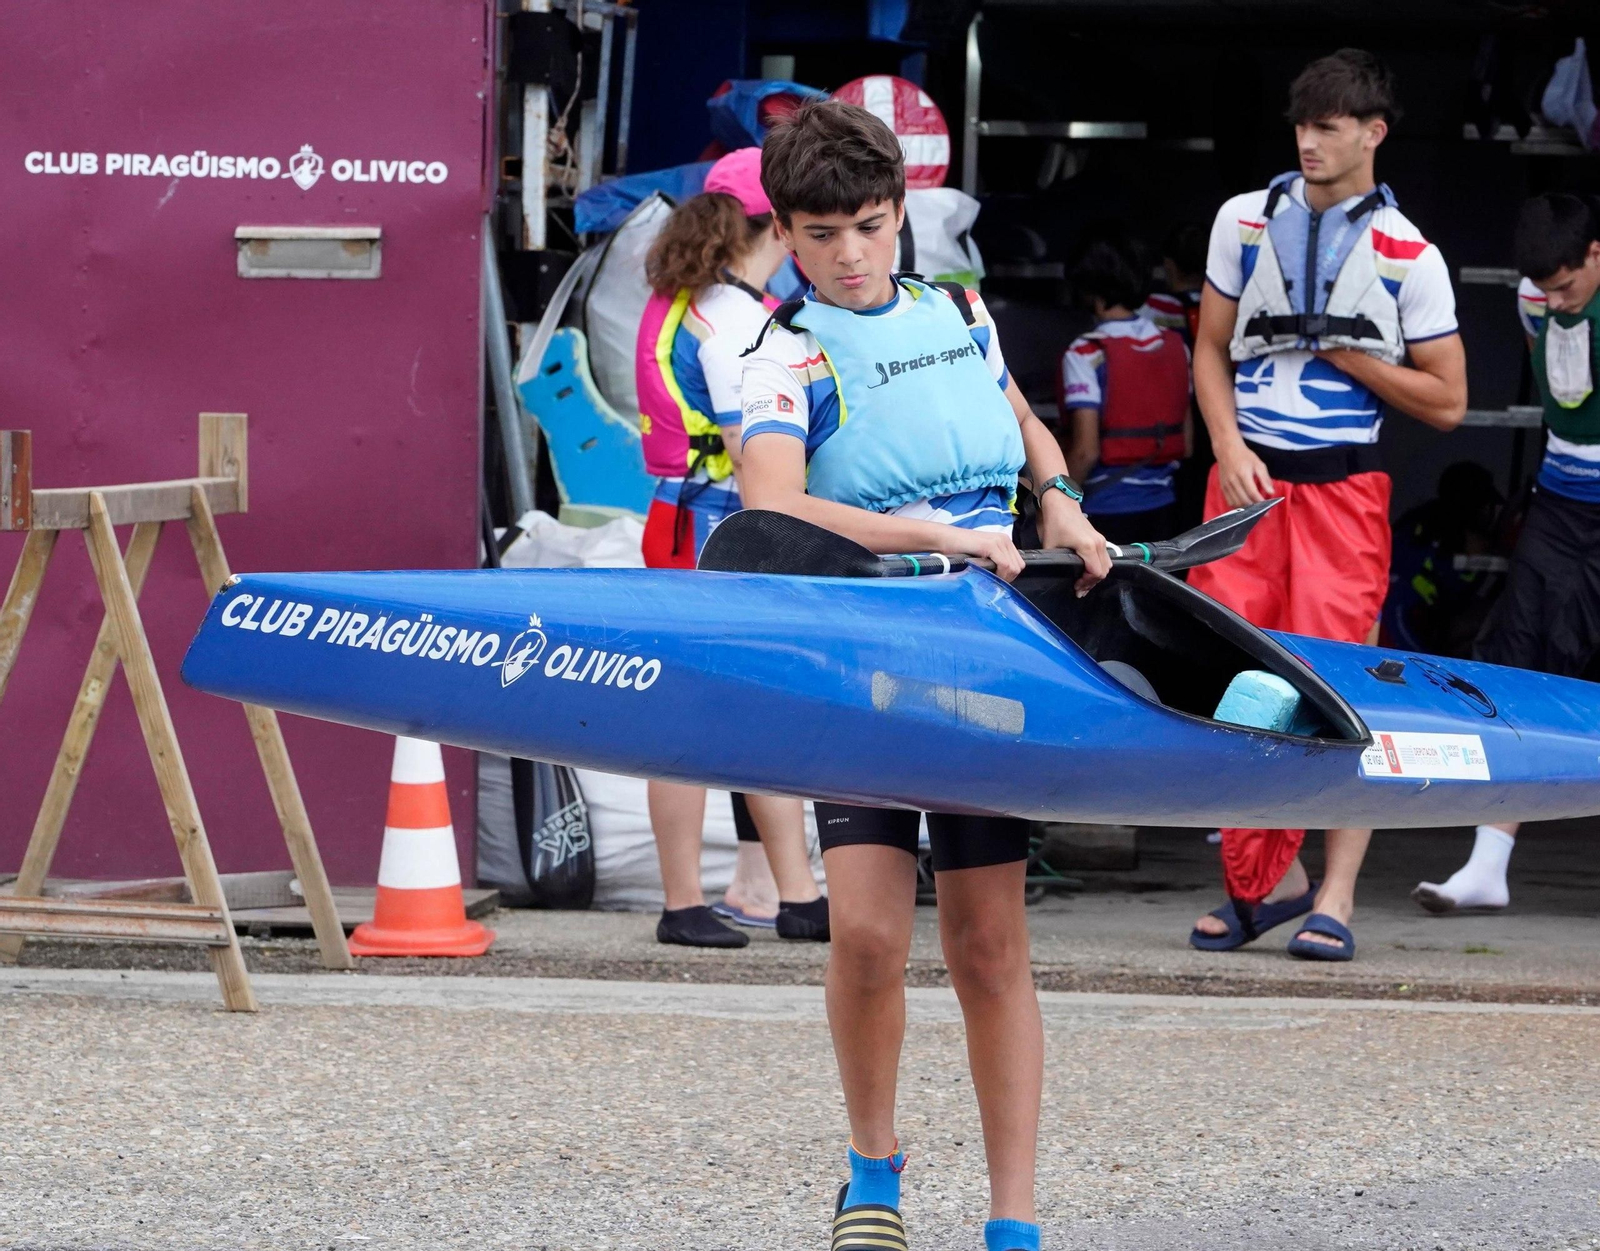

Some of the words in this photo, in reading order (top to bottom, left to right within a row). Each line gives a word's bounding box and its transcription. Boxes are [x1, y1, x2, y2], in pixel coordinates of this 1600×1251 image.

[24, 151, 98, 175] CLUB
[105, 150, 281, 179] PIRAGÜISMO
[331, 159, 448, 184] OLIVICO
[220, 593, 315, 637] CLUB
[308, 607, 500, 668] PIRAGÜISMO
[543, 644, 662, 692] OLIVICO
